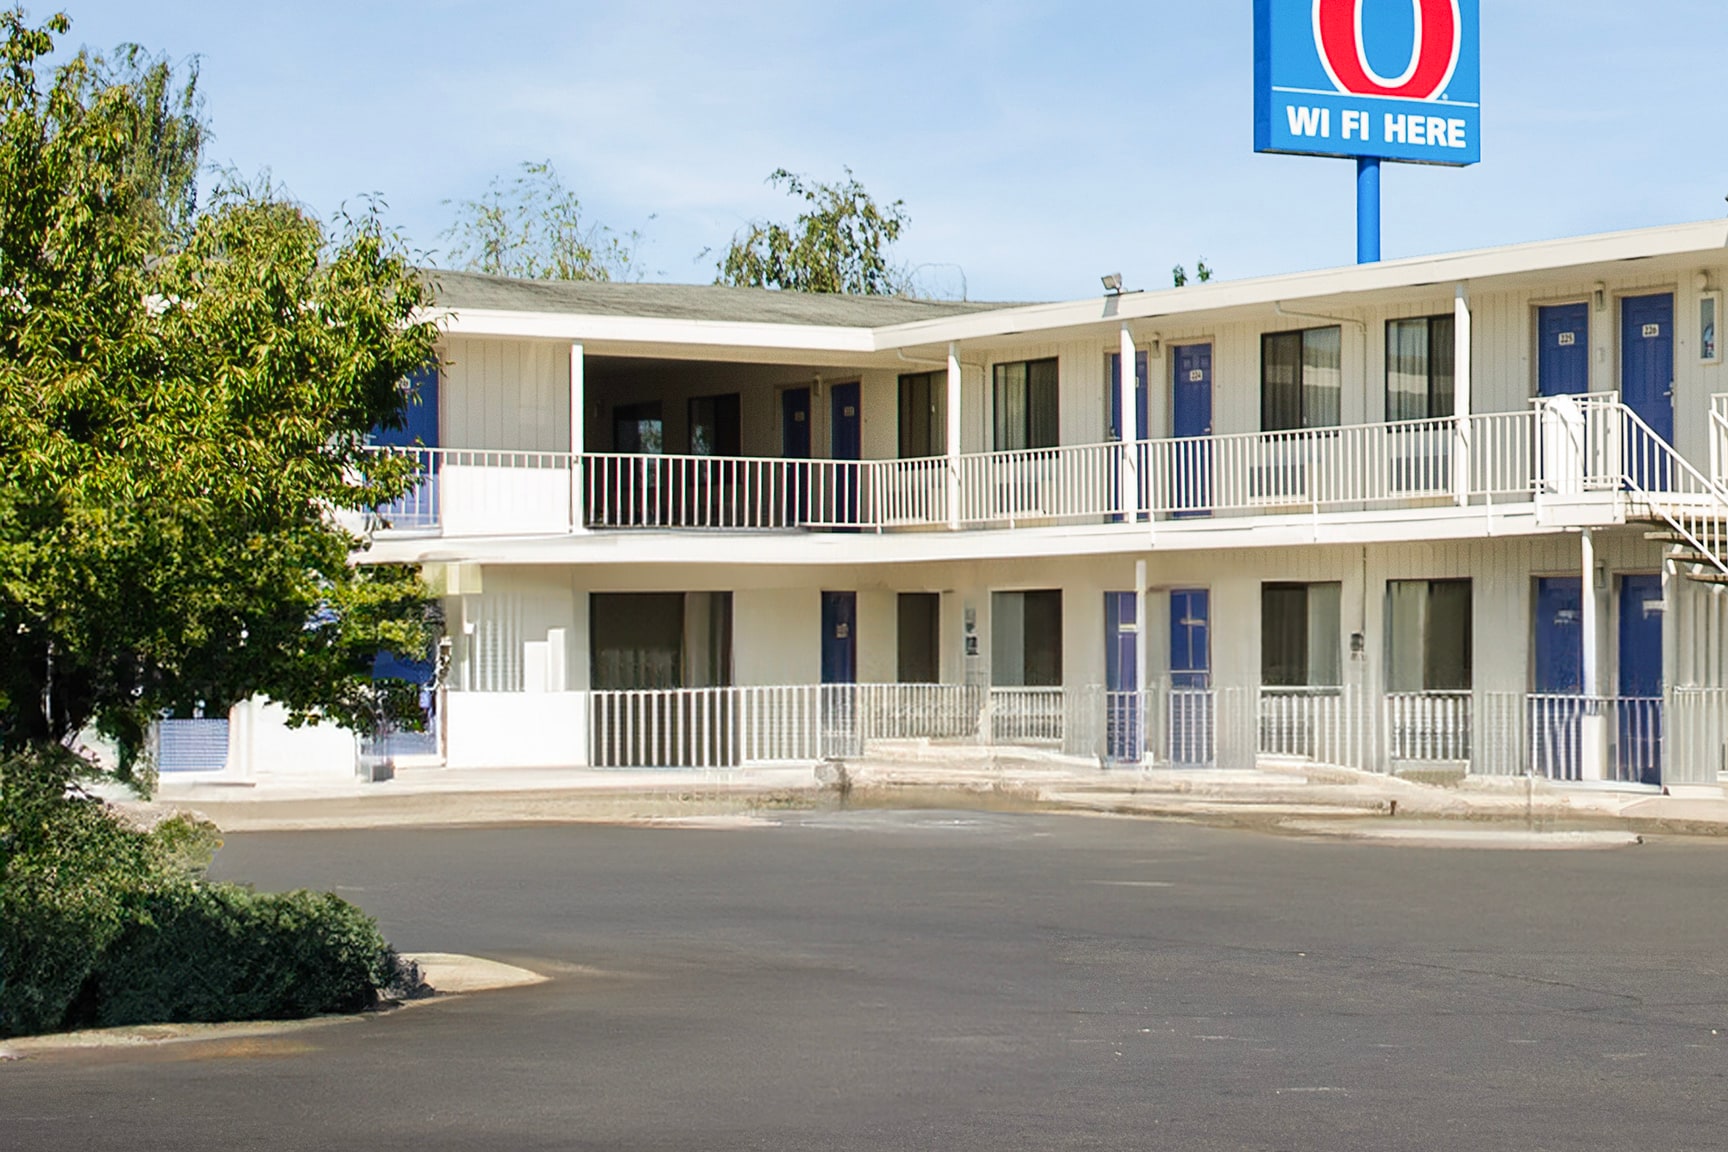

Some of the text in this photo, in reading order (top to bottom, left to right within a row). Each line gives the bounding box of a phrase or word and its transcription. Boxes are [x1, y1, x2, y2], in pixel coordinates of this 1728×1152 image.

[1286, 105, 1466, 148] WI FI HERE
